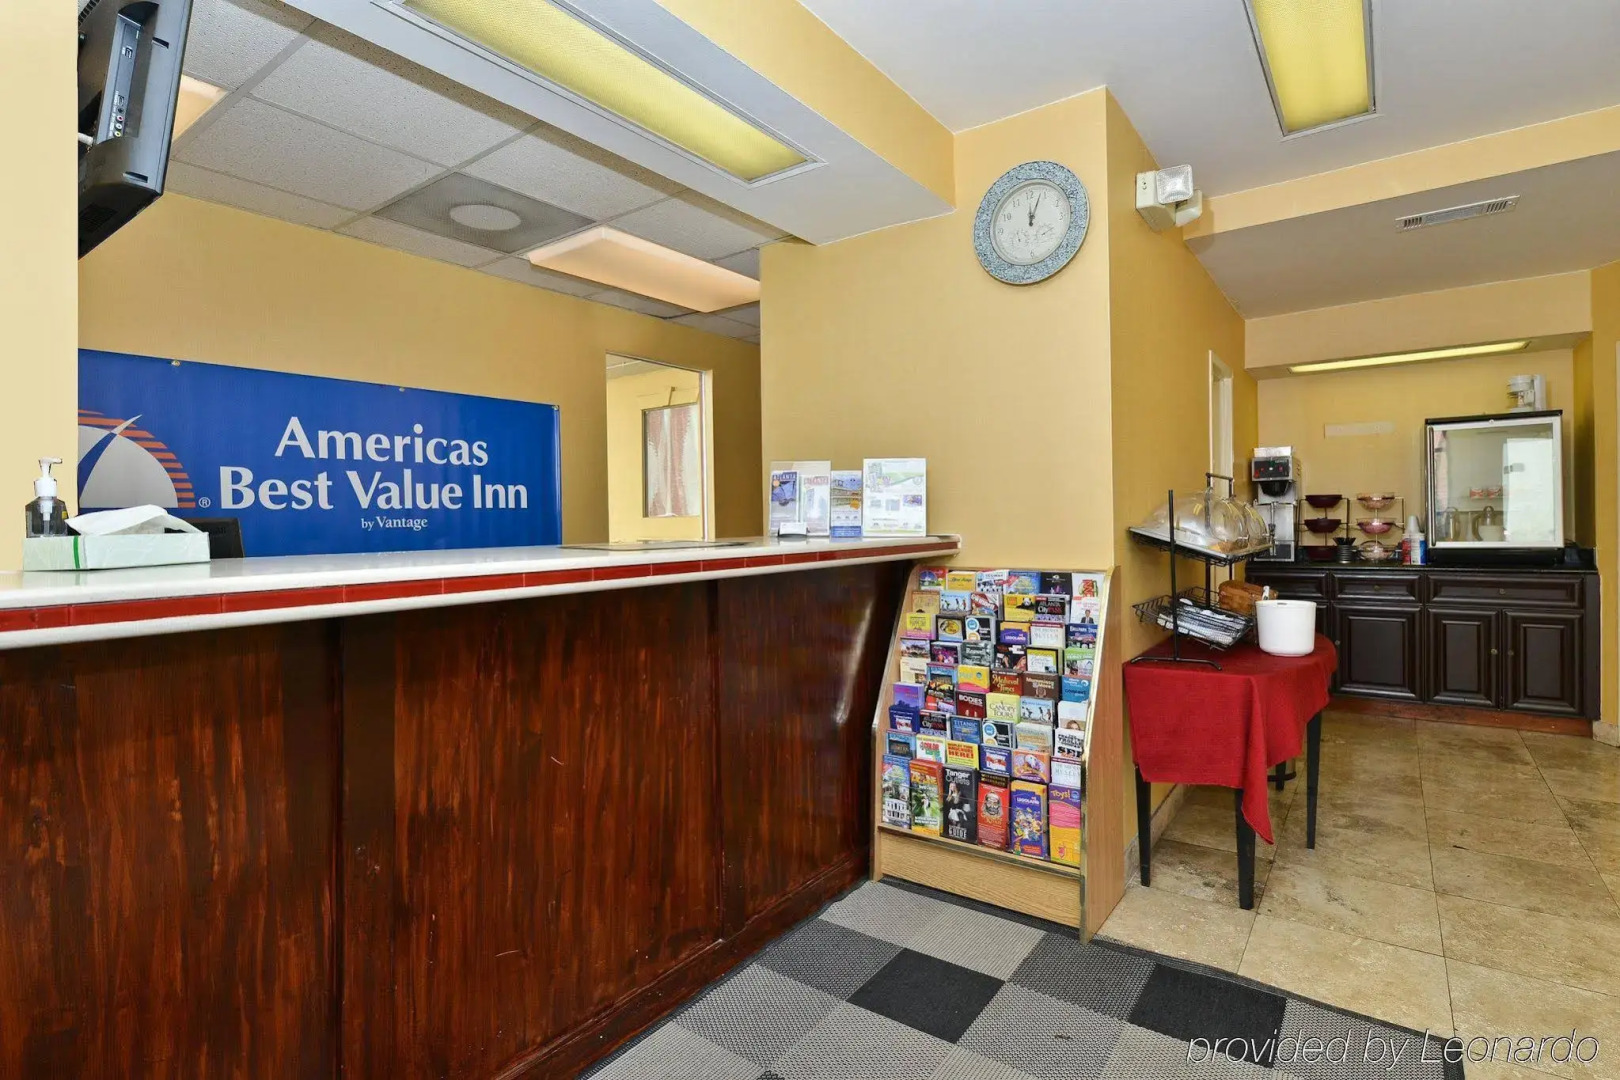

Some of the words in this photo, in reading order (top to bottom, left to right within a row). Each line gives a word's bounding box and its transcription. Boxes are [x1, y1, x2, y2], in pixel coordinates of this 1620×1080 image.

[274, 416, 489, 467] Americas
[220, 466, 334, 511] Best
[346, 470, 463, 511] Value
[472, 474, 529, 510] Inn
[360, 518, 375, 531] by
[376, 516, 428, 531] Vantage
[958, 695, 983, 705] BODIES
[989, 703, 1016, 712] CANOPY
[993, 709, 1014, 717] TOURS
[945, 769, 971, 779] Tanger
[945, 775, 970, 785] Outlets
[1051, 789, 1071, 799] Toys!
